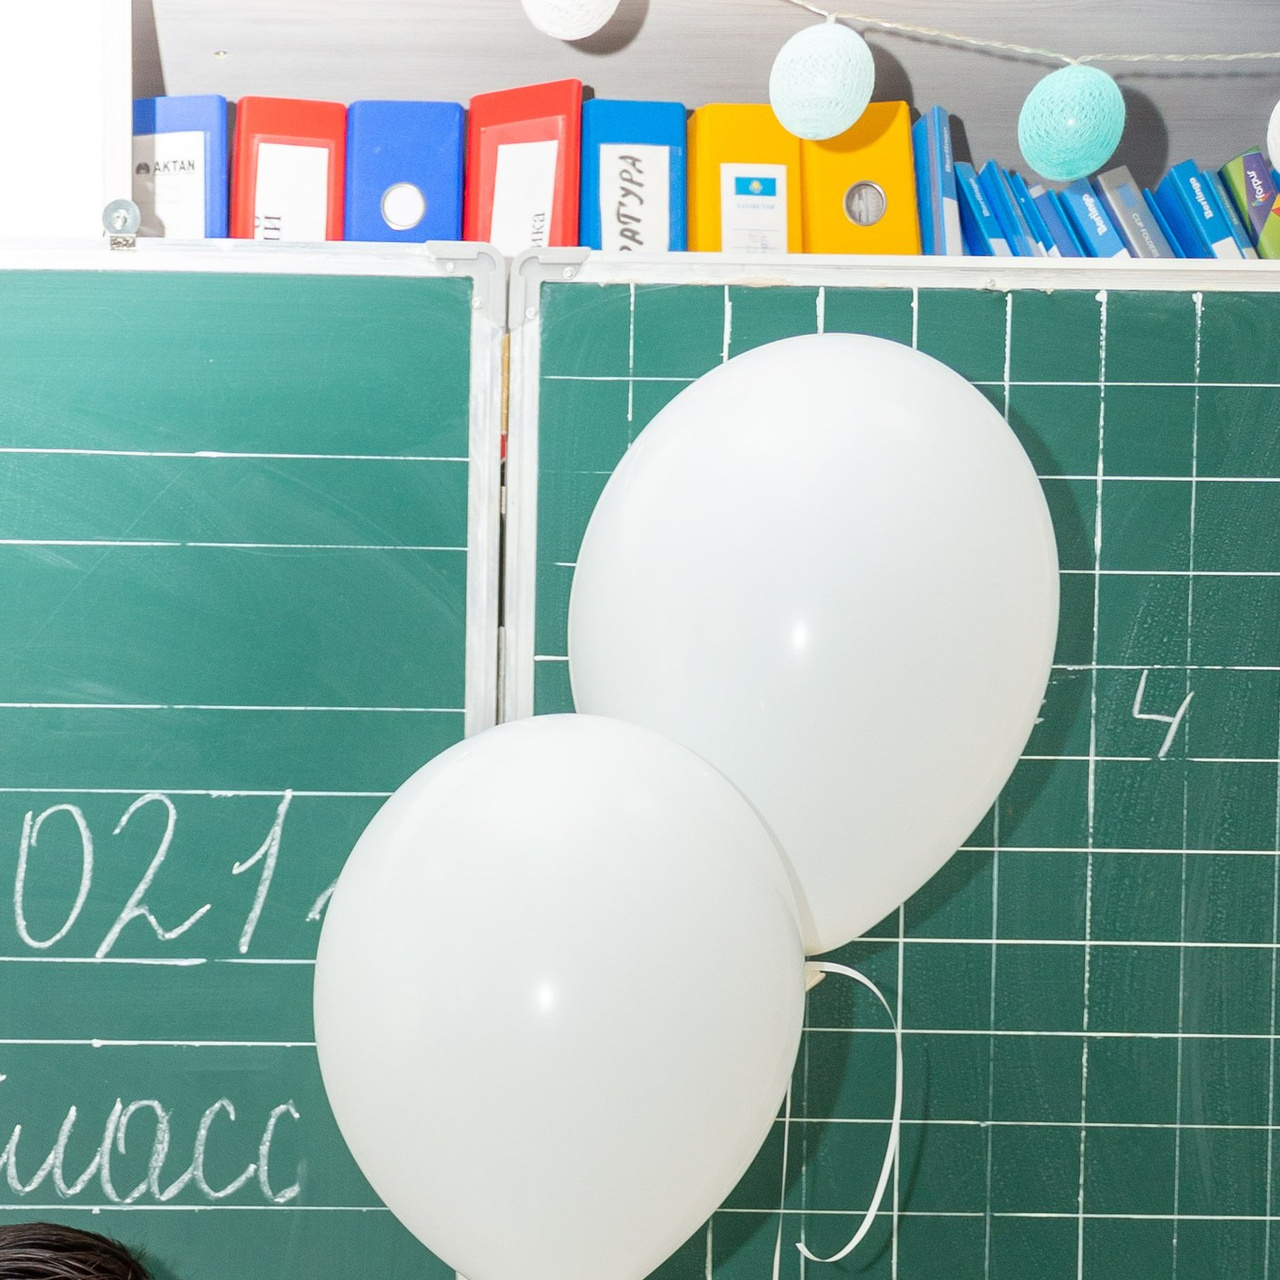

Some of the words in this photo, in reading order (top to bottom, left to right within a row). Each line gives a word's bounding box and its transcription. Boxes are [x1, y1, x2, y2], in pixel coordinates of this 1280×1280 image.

[1189, 177, 1214, 220] Berlingo
[1246, 170, 1265, 199] forpus
[1082, 193, 1108, 236] Berlingo
[1131, 668, 1196, 759] 4
